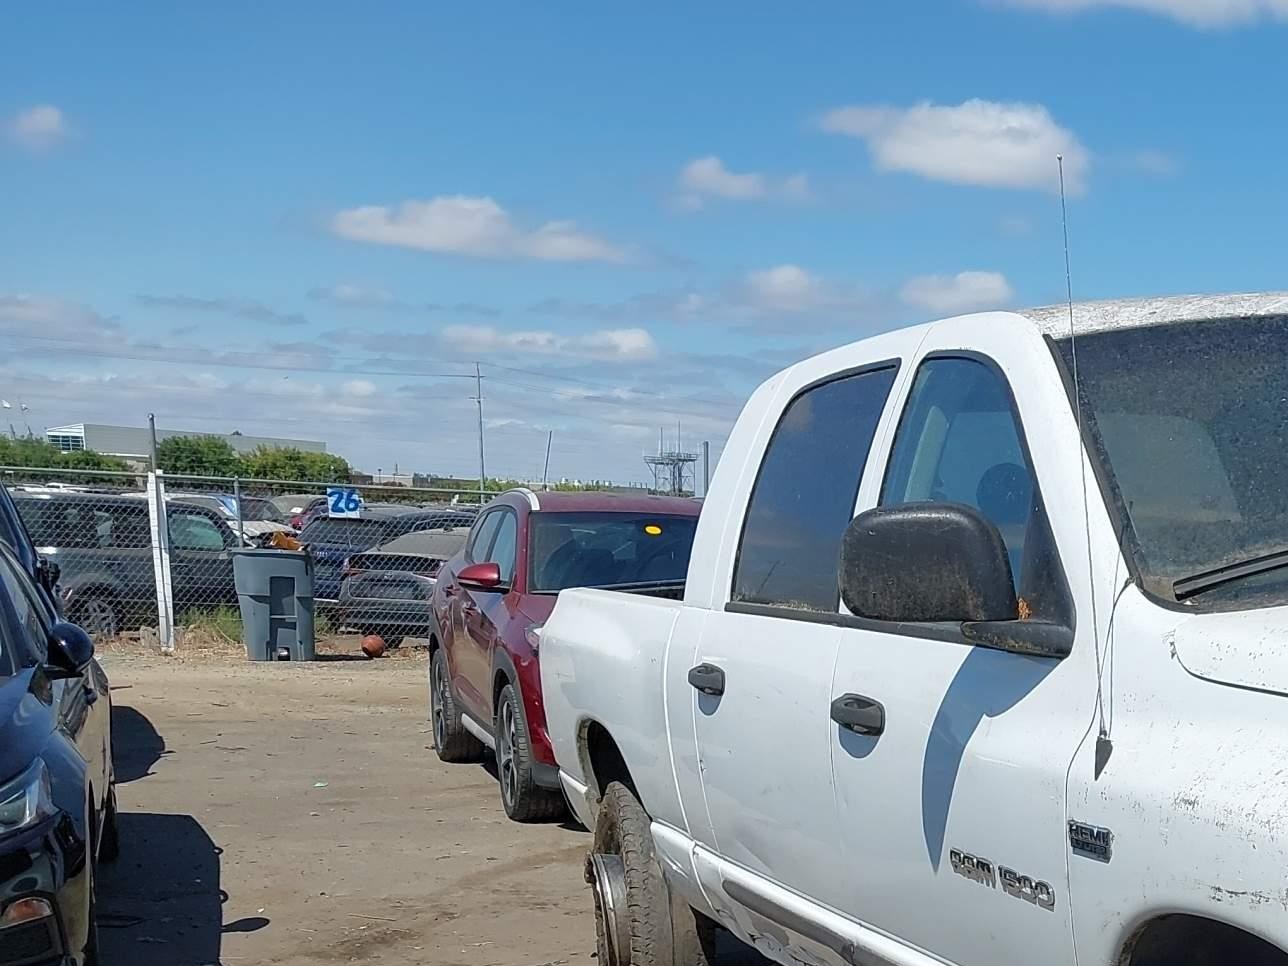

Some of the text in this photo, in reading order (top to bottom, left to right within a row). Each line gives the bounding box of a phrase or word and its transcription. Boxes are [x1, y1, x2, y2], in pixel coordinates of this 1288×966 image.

[328, 489, 360, 513] 26
[1069, 820, 1112, 848] HEMI
[949, 847, 1055, 912] RAM 1500
